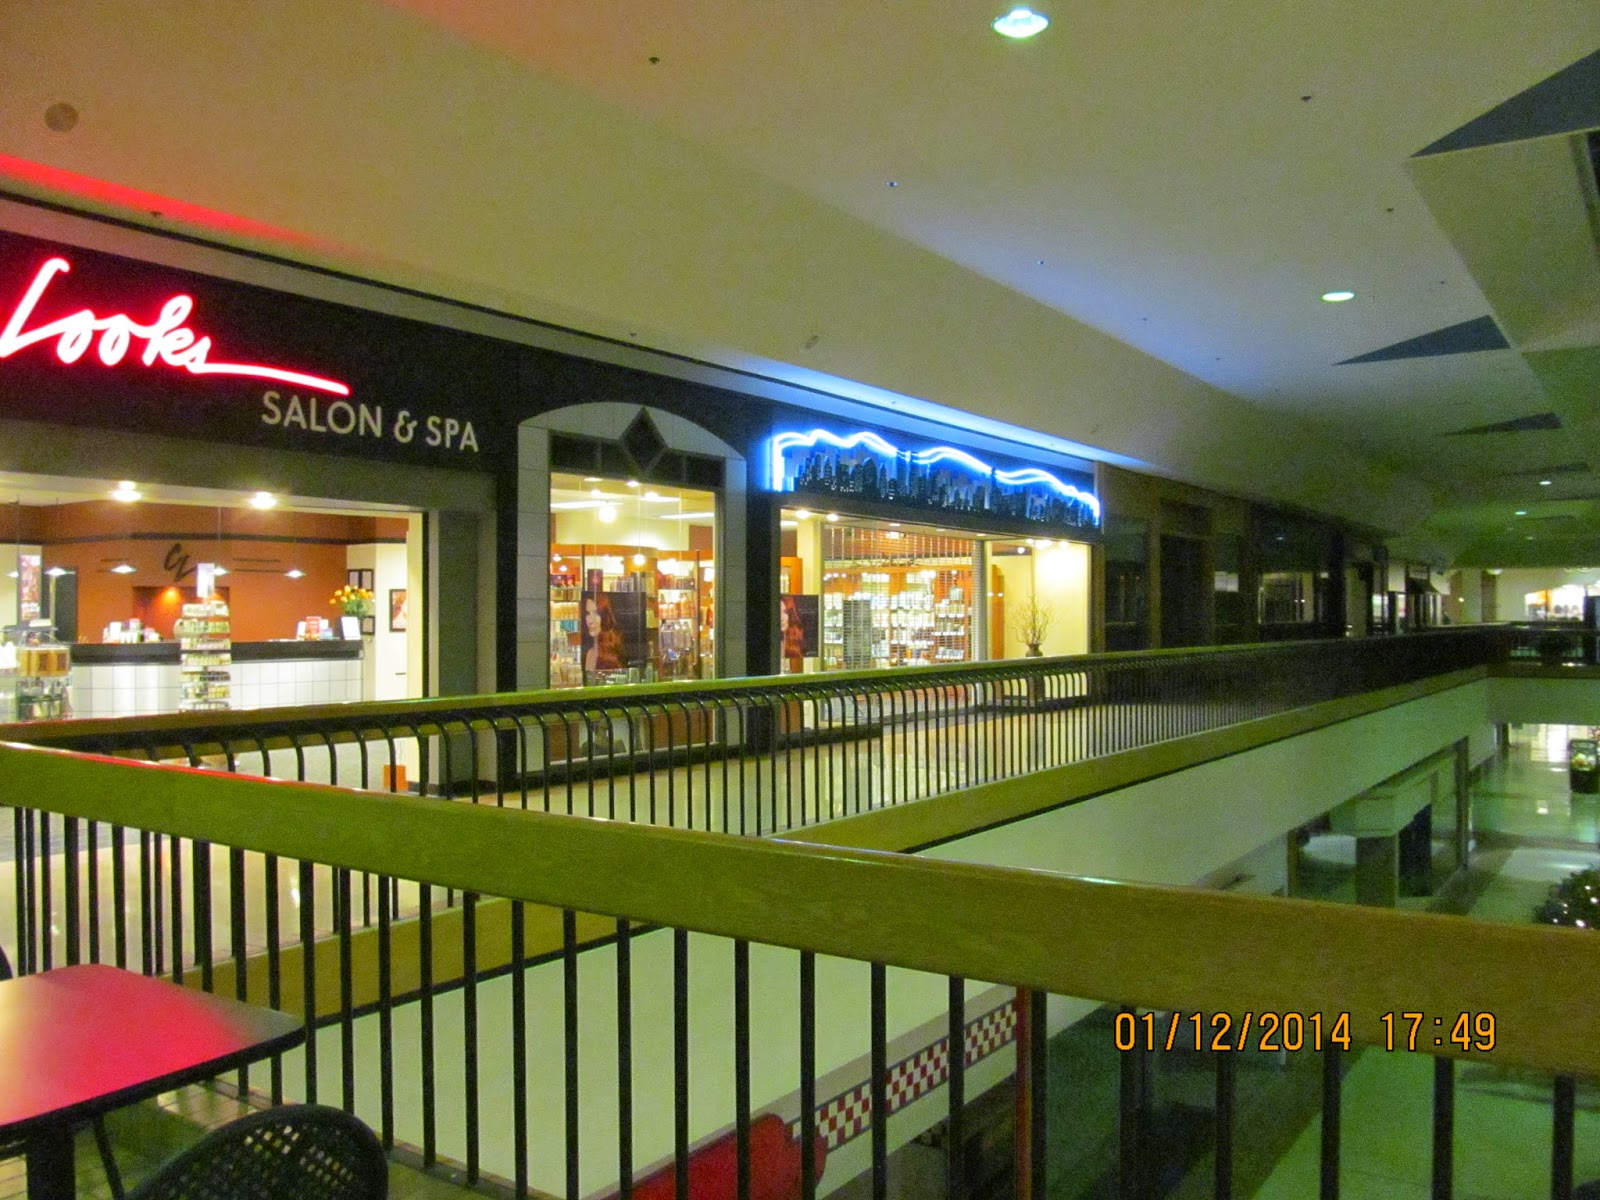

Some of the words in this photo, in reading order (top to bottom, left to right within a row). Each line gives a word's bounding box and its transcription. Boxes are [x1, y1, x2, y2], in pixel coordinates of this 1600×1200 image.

[0, 257, 352, 396] Looks
[261, 390, 382, 438] SALON
[393, 409, 418, 443] &
[425, 415, 479, 453] SPA
